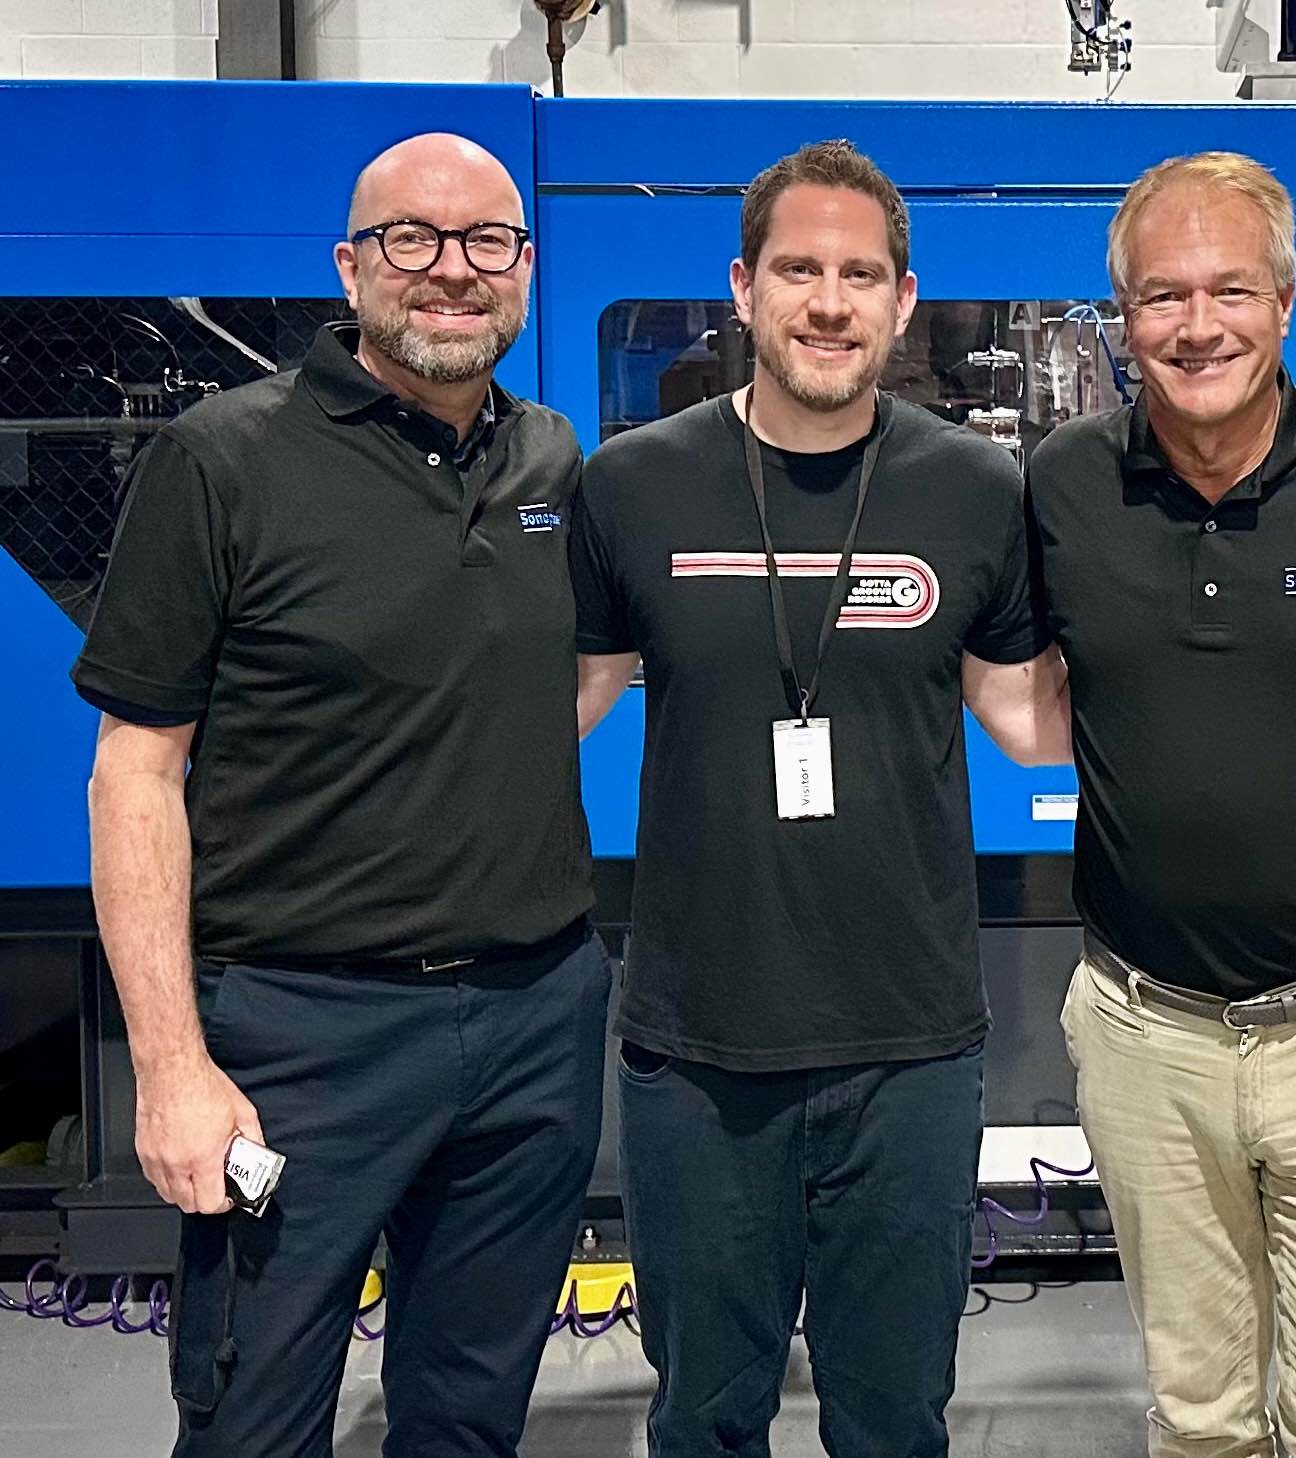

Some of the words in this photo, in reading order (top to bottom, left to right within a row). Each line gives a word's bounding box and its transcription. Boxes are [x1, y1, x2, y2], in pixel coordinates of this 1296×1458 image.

[860, 579, 891, 587] GOTTA
[852, 587, 891, 595] GROOVE
[801, 768, 811, 806] Visitor
